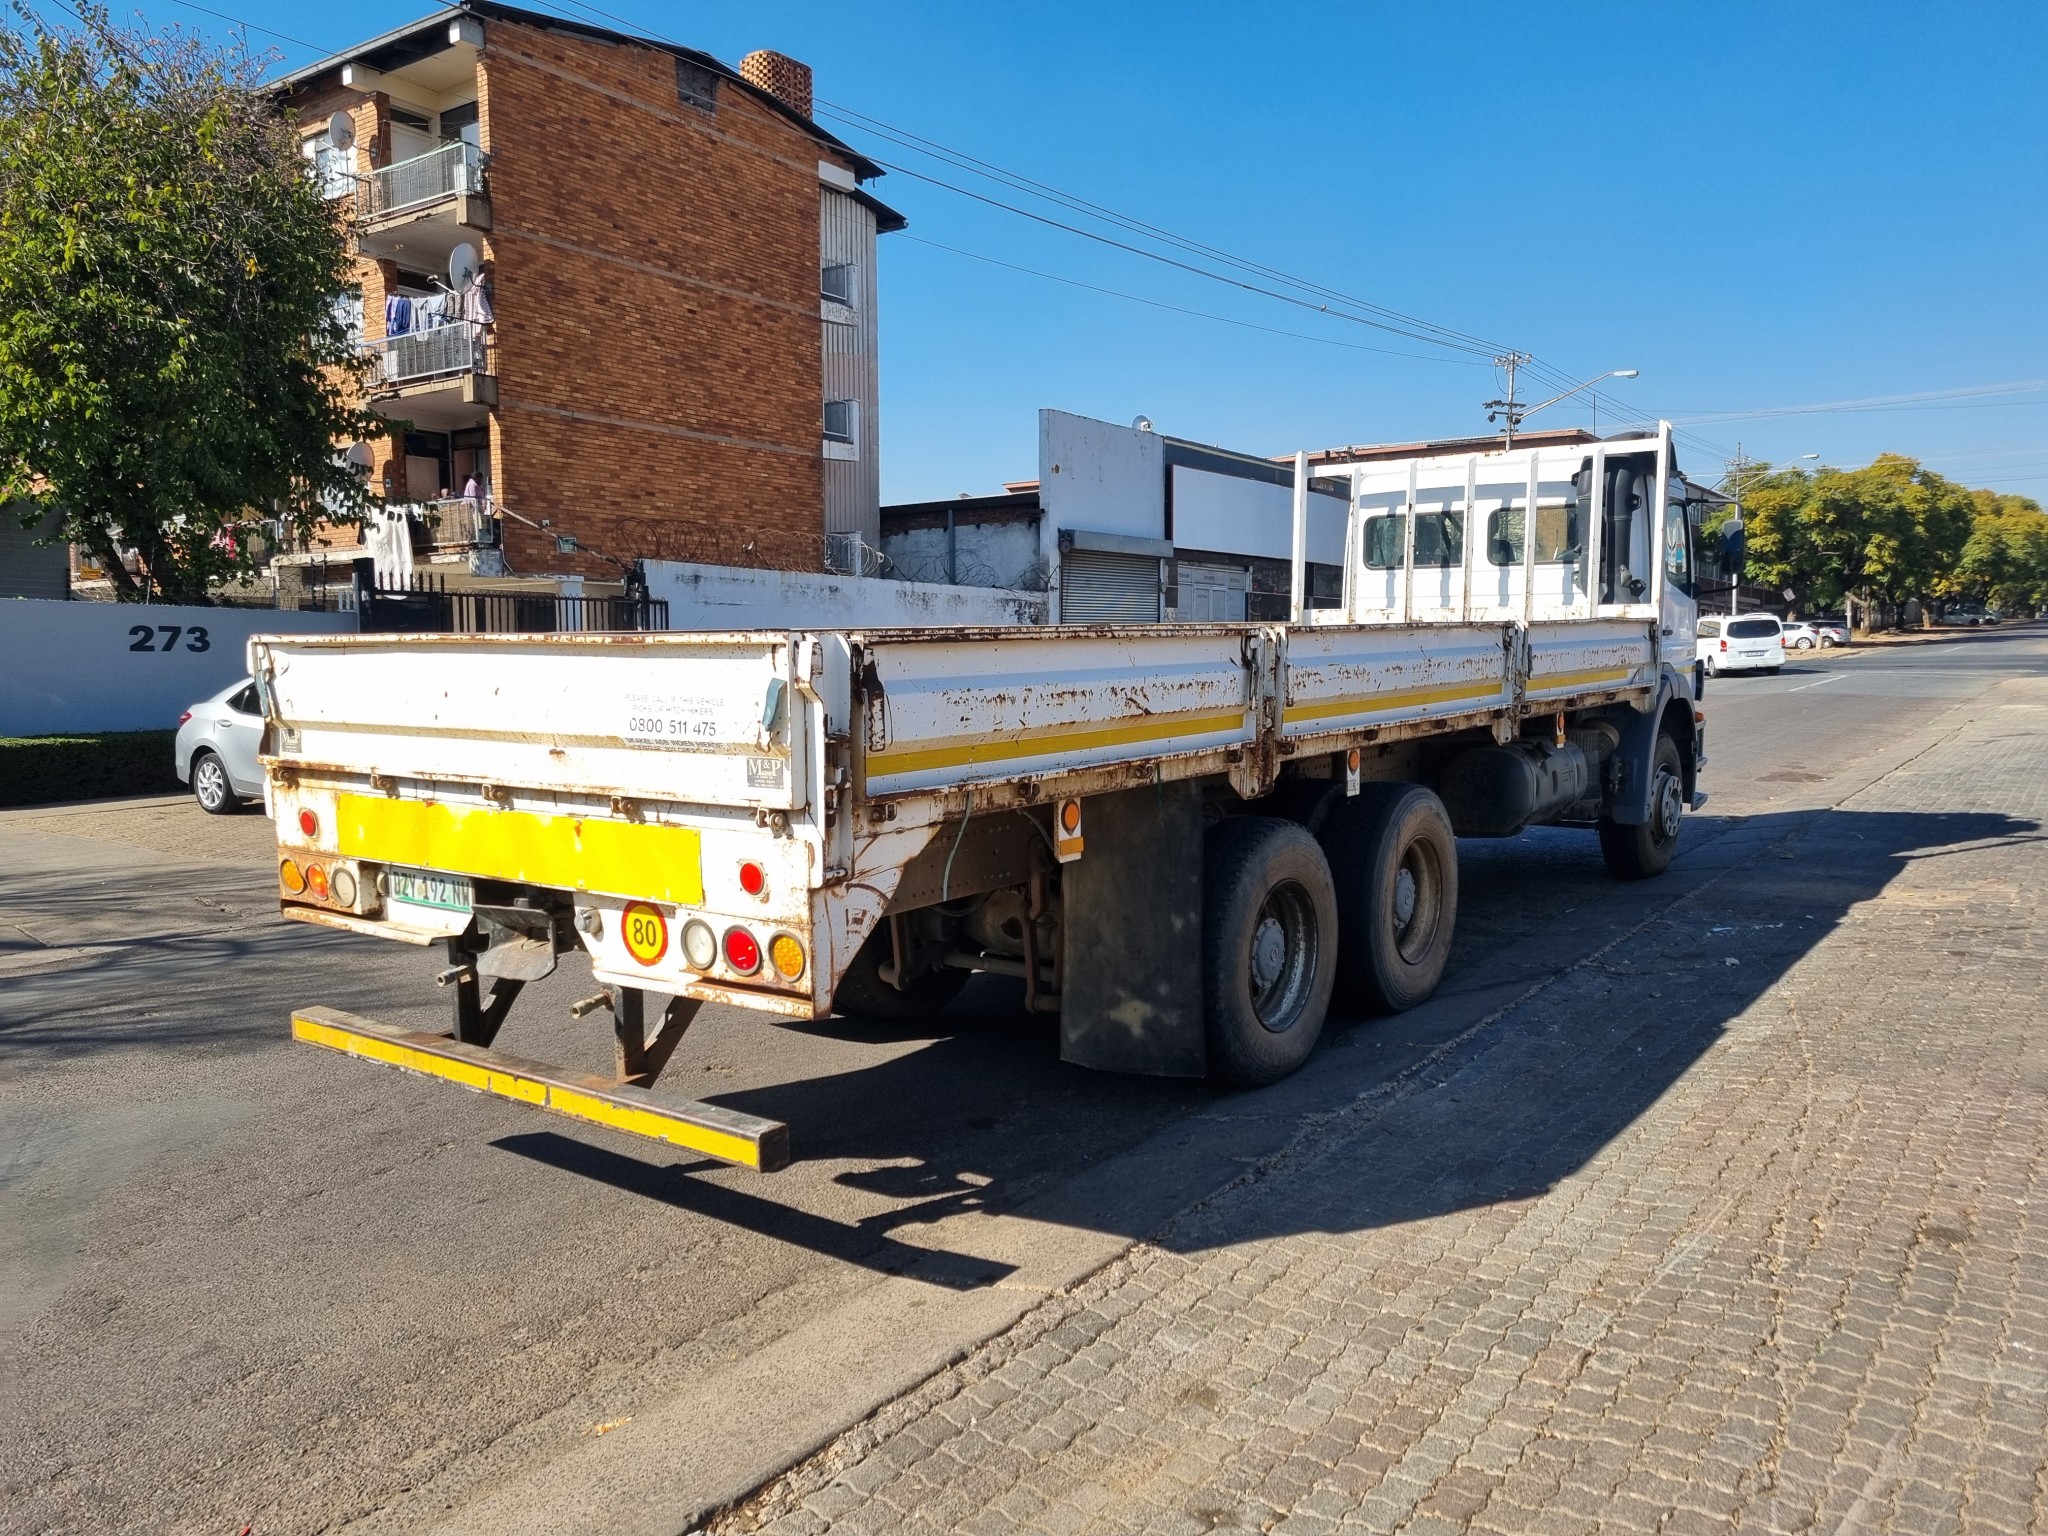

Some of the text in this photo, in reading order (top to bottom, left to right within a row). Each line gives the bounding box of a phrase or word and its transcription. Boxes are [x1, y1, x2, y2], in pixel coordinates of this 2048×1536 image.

[128, 624, 211, 653] 273
[625, 693, 649, 703] PLEASE
[679, 696, 694, 705] THIS
[697, 697, 724, 707] VEHICLE
[666, 706, 686, 715] HITCH
[629, 717, 717, 737] 0800 511 475
[748, 758, 781, 777] M&P
[392, 871, 416, 898] DZY
[421, 875, 447, 903] 192
[633, 917, 657, 948] 80
